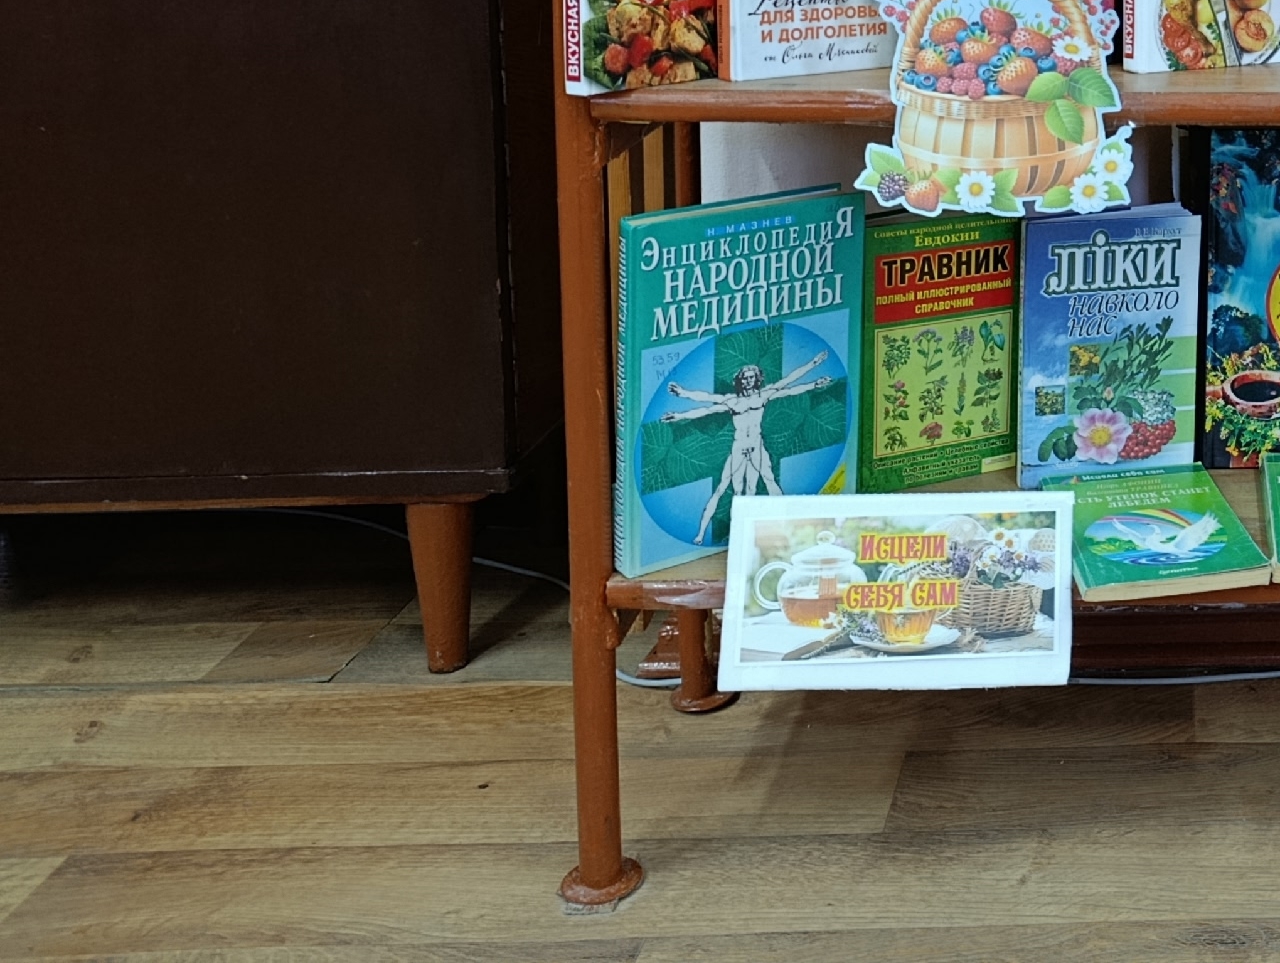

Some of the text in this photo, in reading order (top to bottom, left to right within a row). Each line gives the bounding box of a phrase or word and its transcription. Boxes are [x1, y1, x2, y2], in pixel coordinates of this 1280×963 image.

[760, 9, 795, 26] ДЛЯ
[761, 22, 887, 43] И ДОЛГОЛЕТИЯ
[727, 215, 793, 234] МАЗНЕВ
[664, 241, 834, 303] НАРОДНОЙ
[882, 244, 1010, 287] ТРАВНИК
[1045, 229, 1181, 295] ЛІКИ
[876, 278, 1012, 306] ПОЛНЫЙ ИЛЛЮСТРИРОВАННЫЙ
[915, 296, 974, 314] СПРАВОЧНИК
[1069, 290, 1179, 317] навколо
[651, 273, 843, 342] МЕДИЦИНЫ
[1068, 316, 1117, 337] нас
[1108, 497, 1172, 509] ЛЕБЕДЕМ
[860, 535, 946, 562] ИСЦЕЛИ
[846, 582, 957, 610] СЕБЯ САМ
